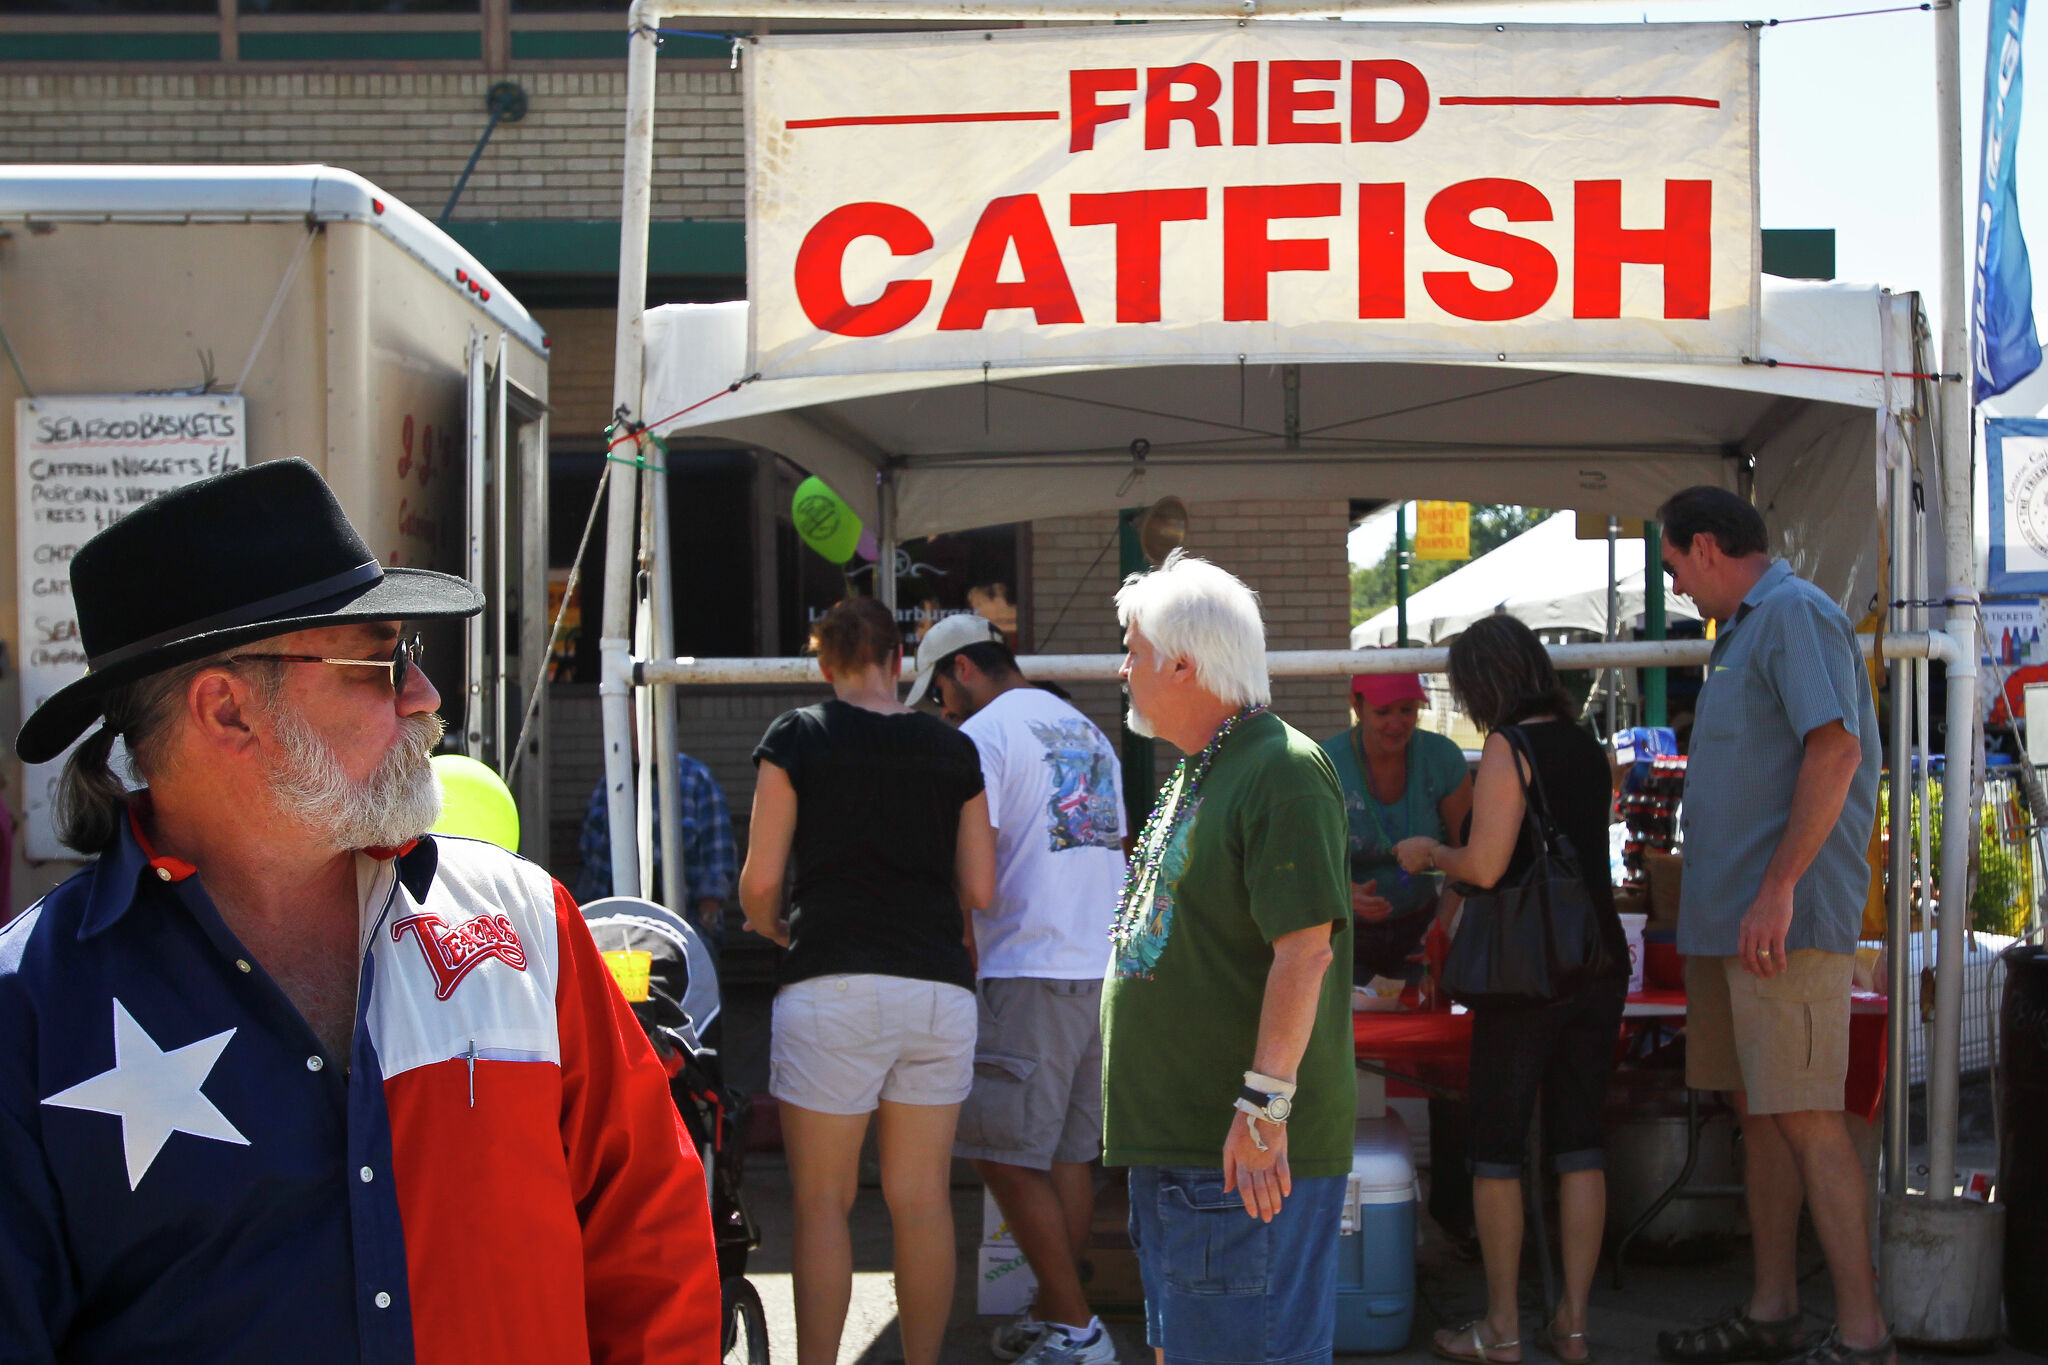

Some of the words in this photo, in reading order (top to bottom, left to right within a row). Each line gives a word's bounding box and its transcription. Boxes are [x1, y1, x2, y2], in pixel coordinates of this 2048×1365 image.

[1070, 60, 1429, 152] FRIED
[795, 178, 1711, 337] CATFISH
[36, 416, 140, 443] SEAFOOD
[140, 411, 235, 440] BASKETS
[112, 454, 204, 478] NUGGETS
[31, 483, 109, 504] POPCORN
